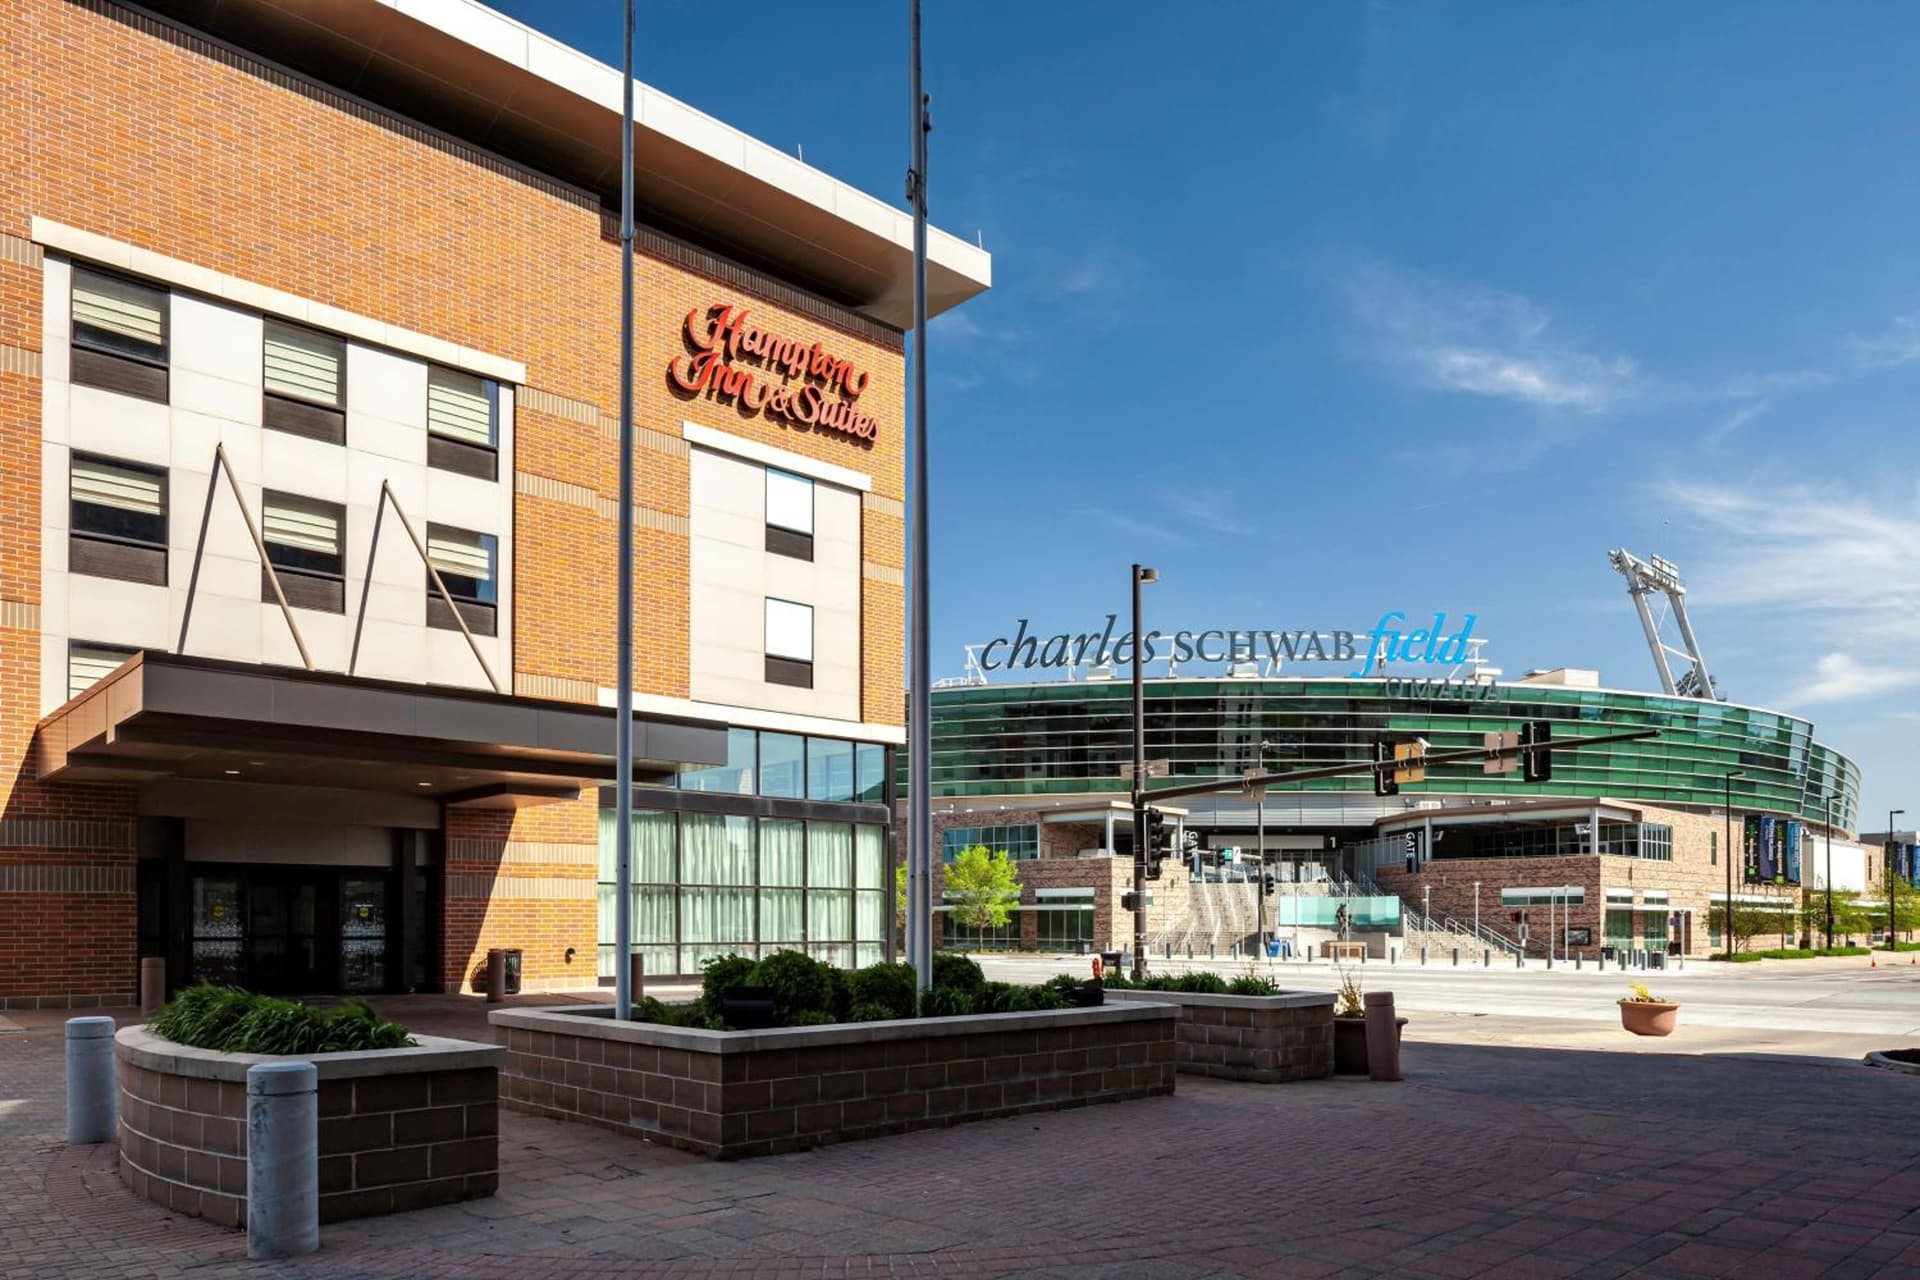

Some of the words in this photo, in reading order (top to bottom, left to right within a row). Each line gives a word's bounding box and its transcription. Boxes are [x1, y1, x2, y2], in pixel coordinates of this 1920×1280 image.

[682, 303, 869, 398] Hampton
[666, 352, 770, 412] Inn
[771, 386, 795, 422] &
[791, 384, 881, 443] Suites
[981, 614, 1161, 671] charles
[1173, 629, 1356, 663] SCHWAB
[1352, 611, 1477, 679] field
[1385, 677, 1501, 701] OMAHA
[1406, 831, 1416, 859] GATE
